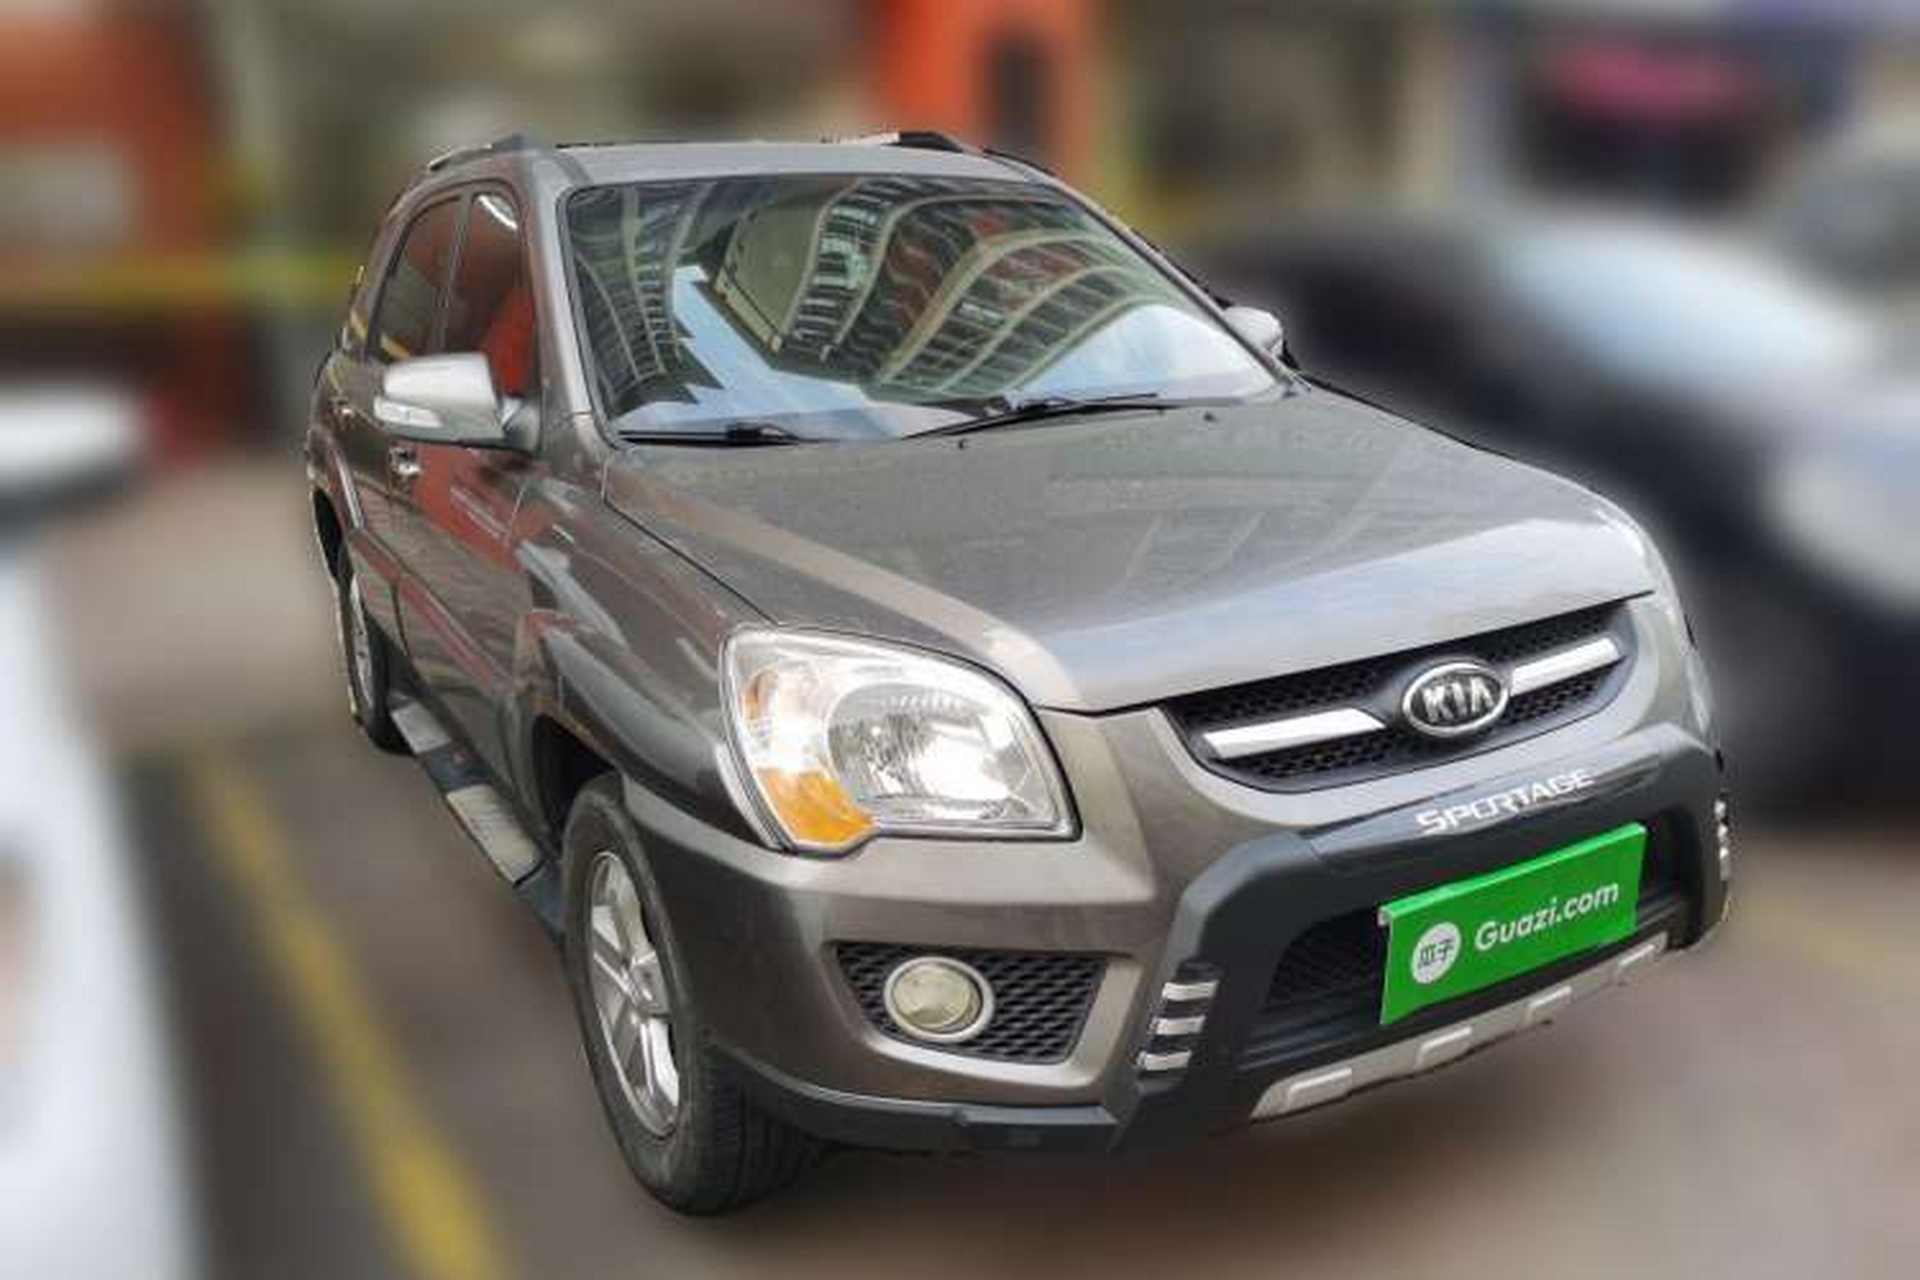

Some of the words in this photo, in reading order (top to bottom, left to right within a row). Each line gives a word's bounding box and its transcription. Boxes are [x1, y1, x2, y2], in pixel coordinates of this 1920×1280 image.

[1423, 677, 1495, 723] KIA
[1416, 769, 1595, 834] SPORTAGE
[1474, 882, 1619, 951] Guazi.com
